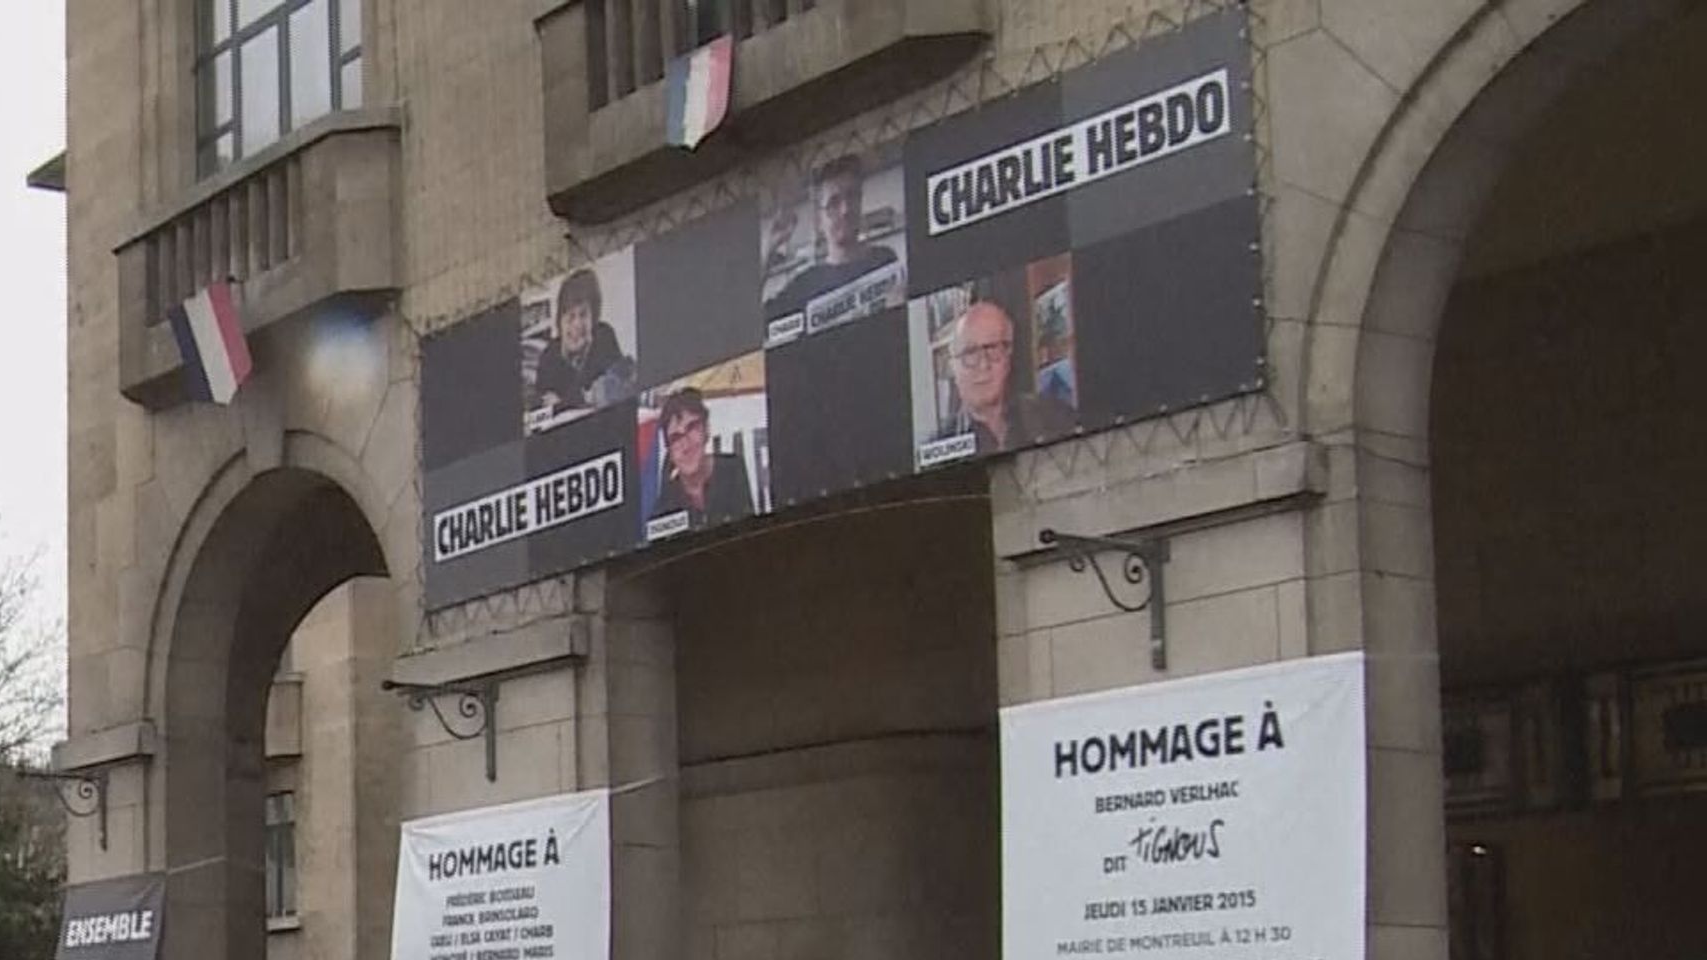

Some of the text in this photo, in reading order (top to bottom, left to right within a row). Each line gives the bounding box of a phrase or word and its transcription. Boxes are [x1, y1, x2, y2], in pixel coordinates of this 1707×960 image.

[930, 79, 1226, 226] CHARLIE HEBDO
[435, 461, 621, 557] CHARLIE HEBDO
[1054, 701, 1284, 778] HOMMAGE À
[1095, 781, 1239, 814] BERNARD VERLHAC
[428, 828, 559, 880] HOMMAGE À
[1103, 855, 1127, 875] DIT
[1084, 889, 1256, 921] JEUDI 15 JANVIER 2015
[66, 910, 153, 948] ENSEMBLE
[1057, 925, 1291, 956] MAIRIE DE MONTREUIL À 12 H 30
